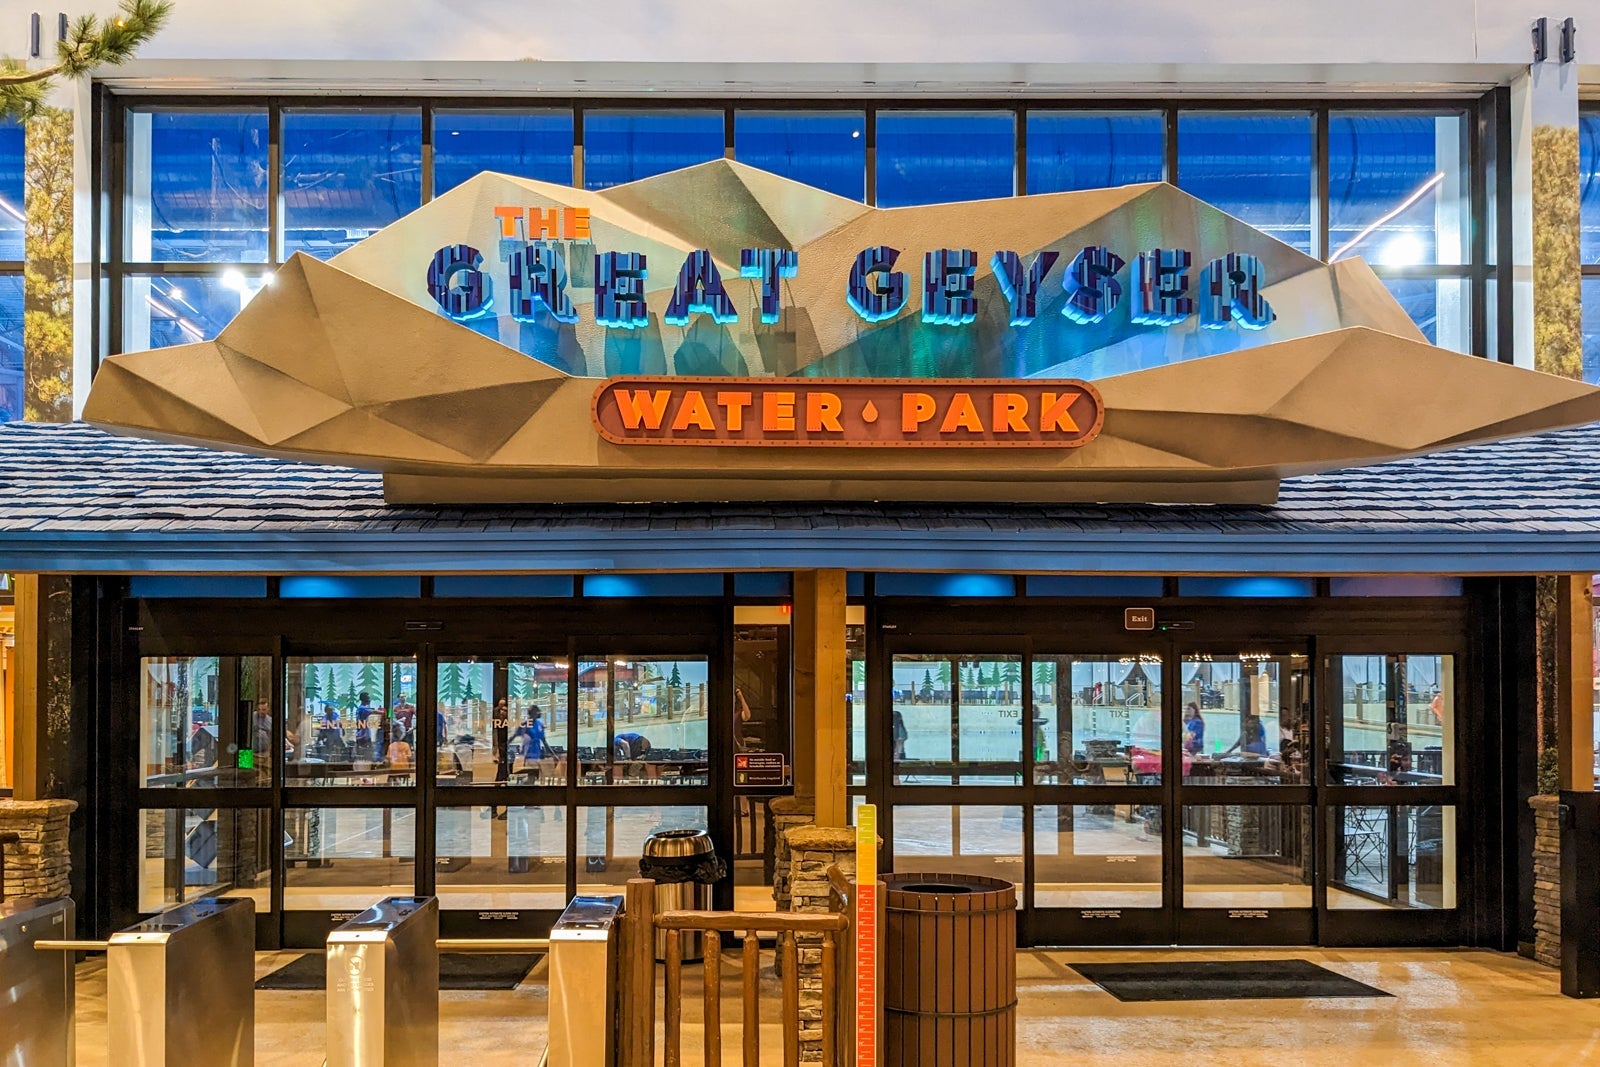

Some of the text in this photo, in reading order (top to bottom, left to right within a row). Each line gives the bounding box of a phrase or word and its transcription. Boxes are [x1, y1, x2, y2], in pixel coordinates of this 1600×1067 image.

[494, 206, 591, 240] THE
[427, 243, 1278, 331] GREAT GEYSER
[613, 389, 1081, 433] WATER PARK
[472, 719, 534, 729] TRACE
